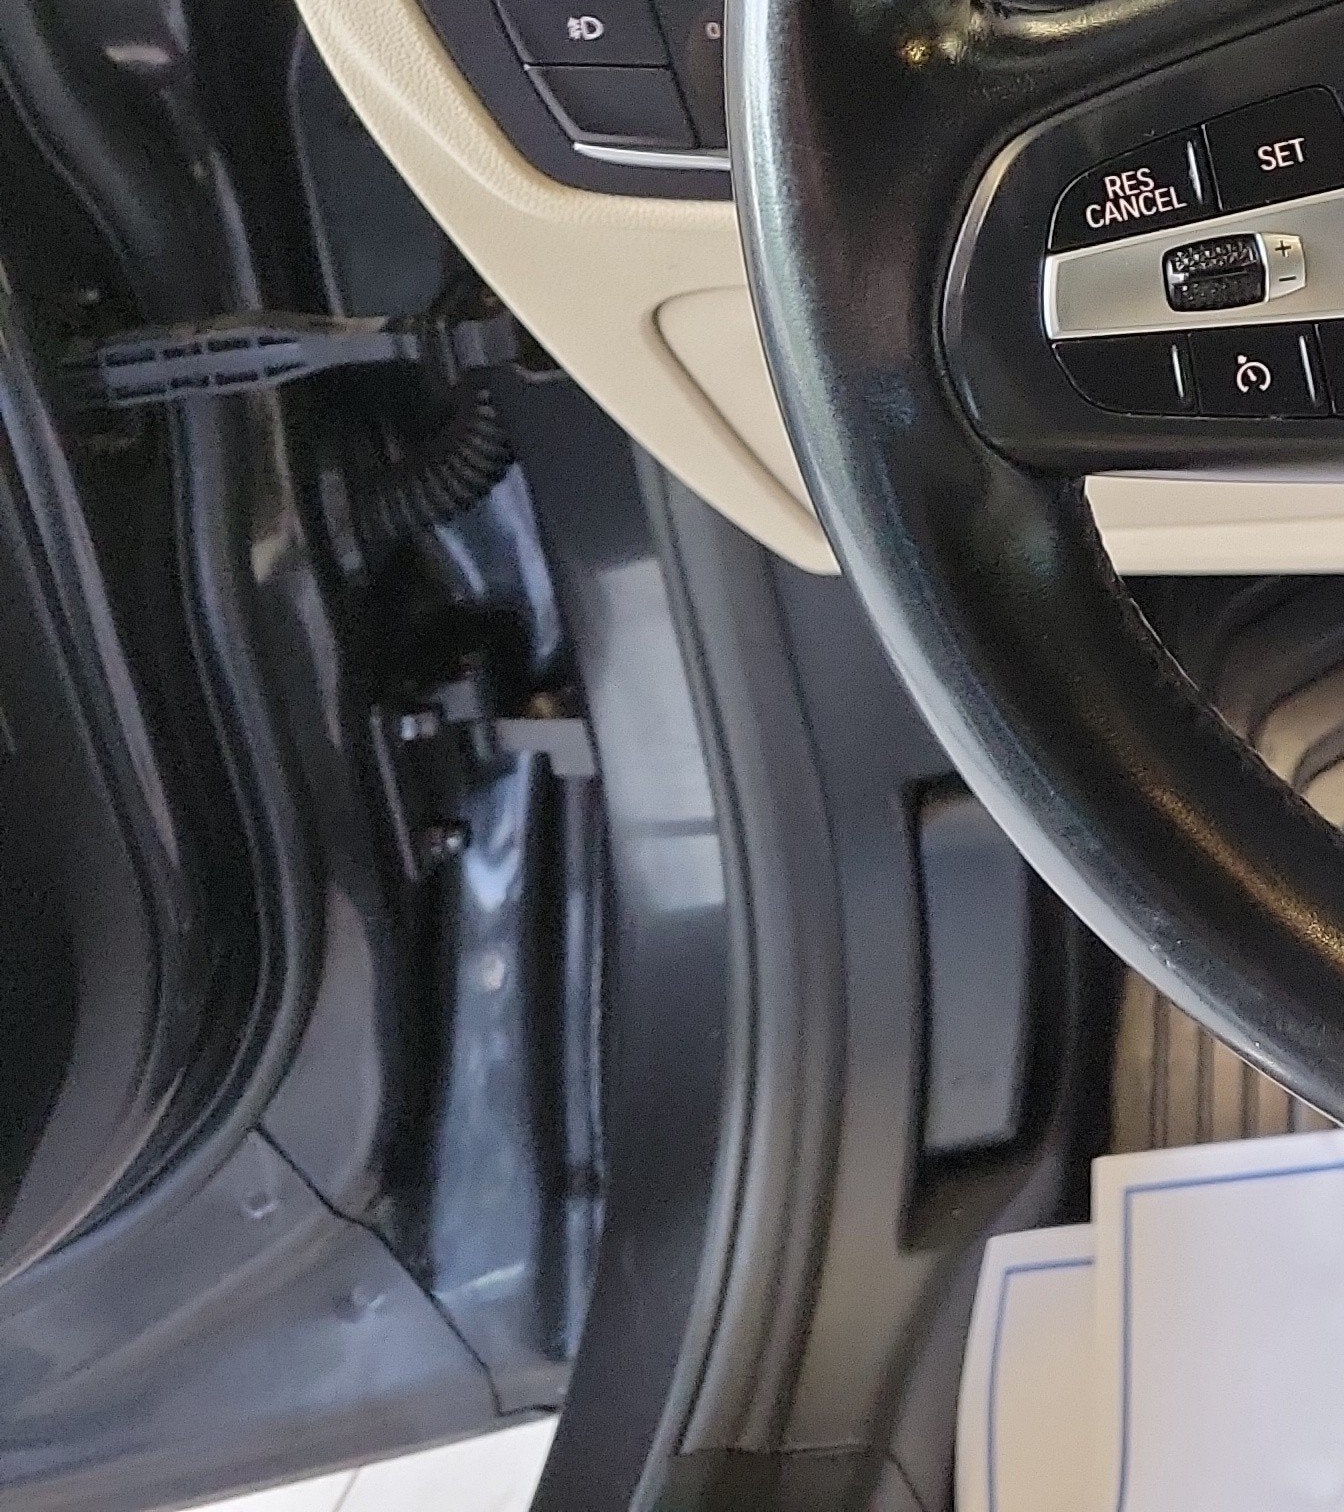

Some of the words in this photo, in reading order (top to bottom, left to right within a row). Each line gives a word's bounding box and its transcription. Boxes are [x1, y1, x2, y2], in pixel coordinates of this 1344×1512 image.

[1256, 137, 1306, 173] SET
[1104, 166, 1156, 200] RES
[1084, 185, 1188, 230] CANCEL
